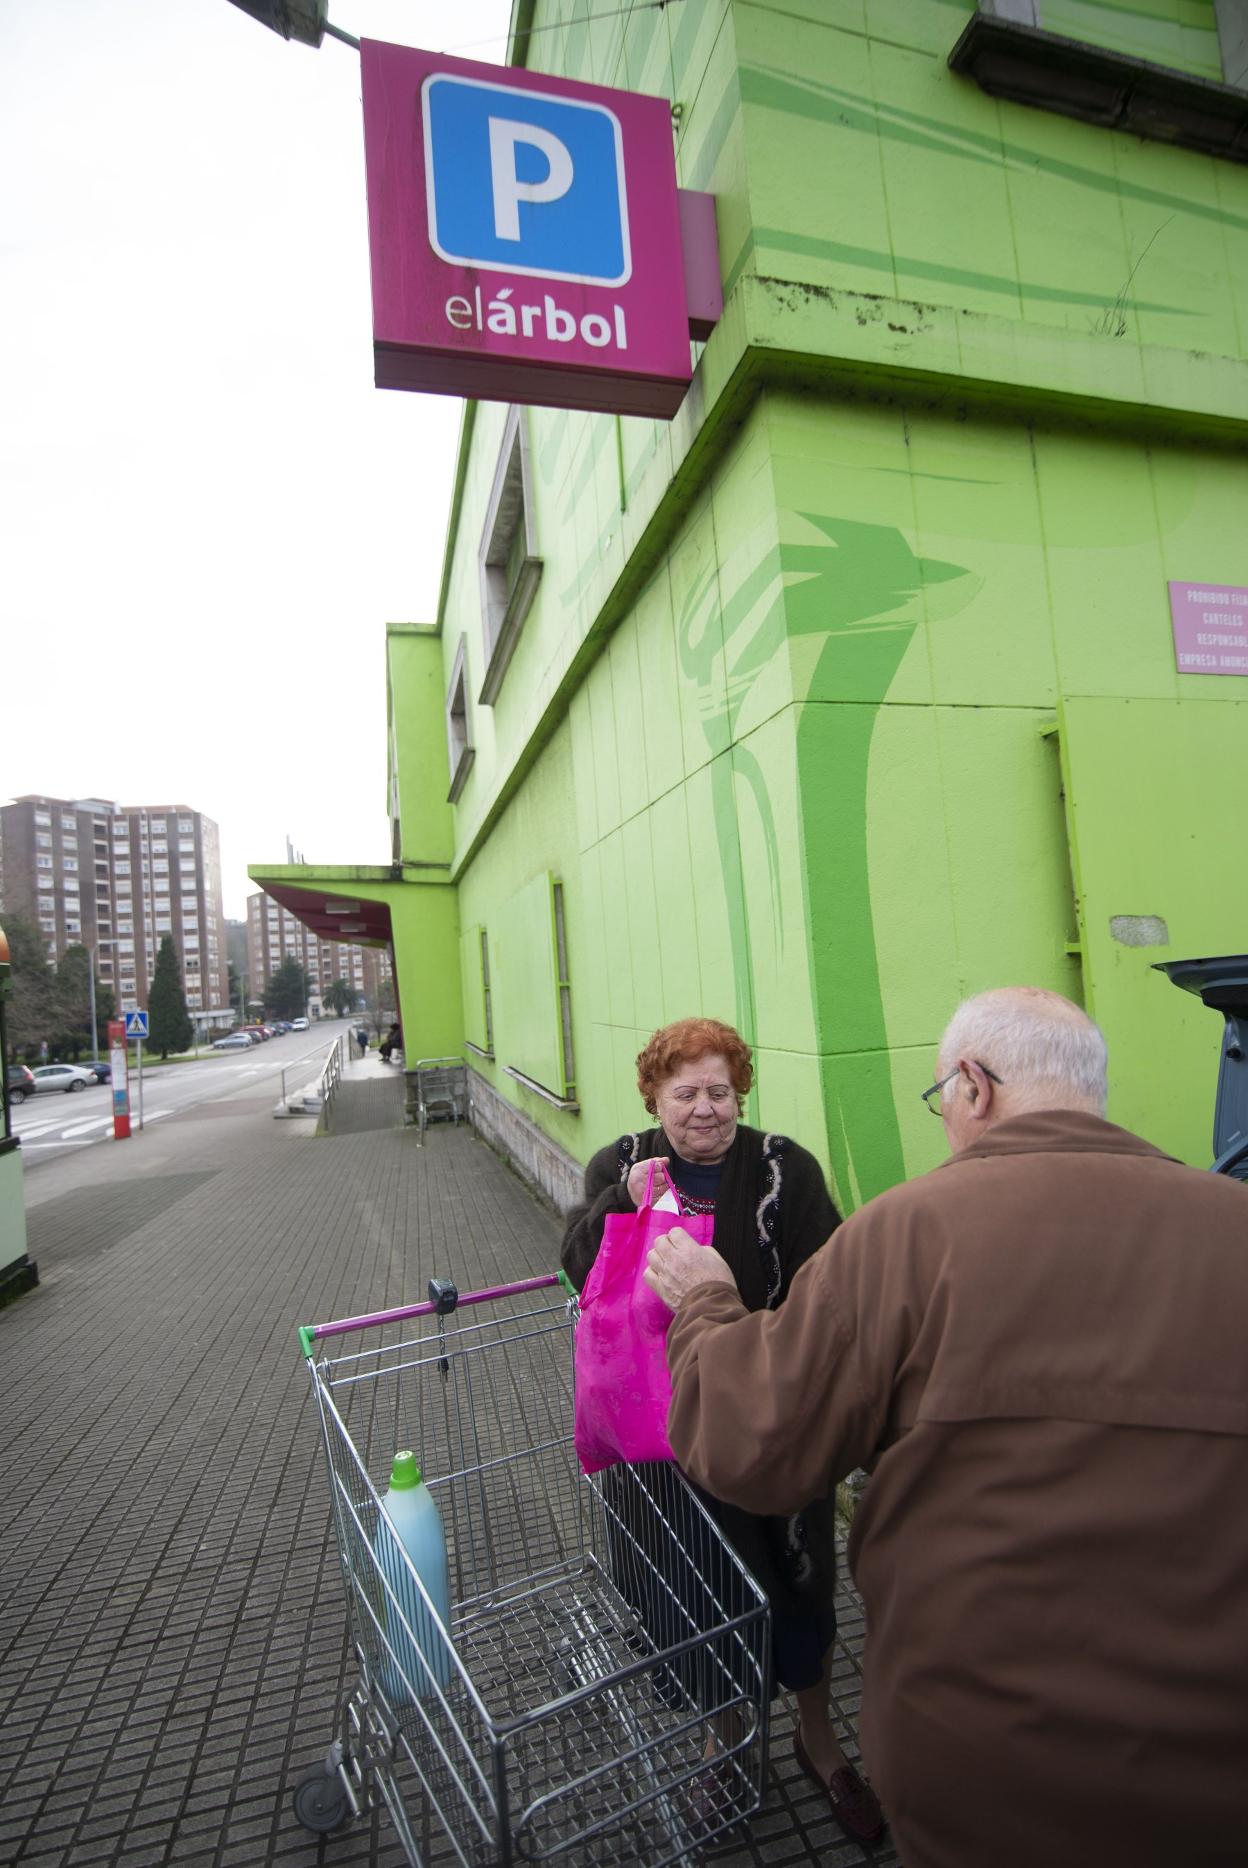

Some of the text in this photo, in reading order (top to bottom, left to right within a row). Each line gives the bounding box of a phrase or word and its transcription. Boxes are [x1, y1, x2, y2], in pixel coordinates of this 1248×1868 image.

[488, 115, 575, 243] P
[1202, 612, 1243, 626] CARTELES
[1196, 632, 1248, 648] RESPONSABL
[1179, 652, 1217, 667] EMPRESA
